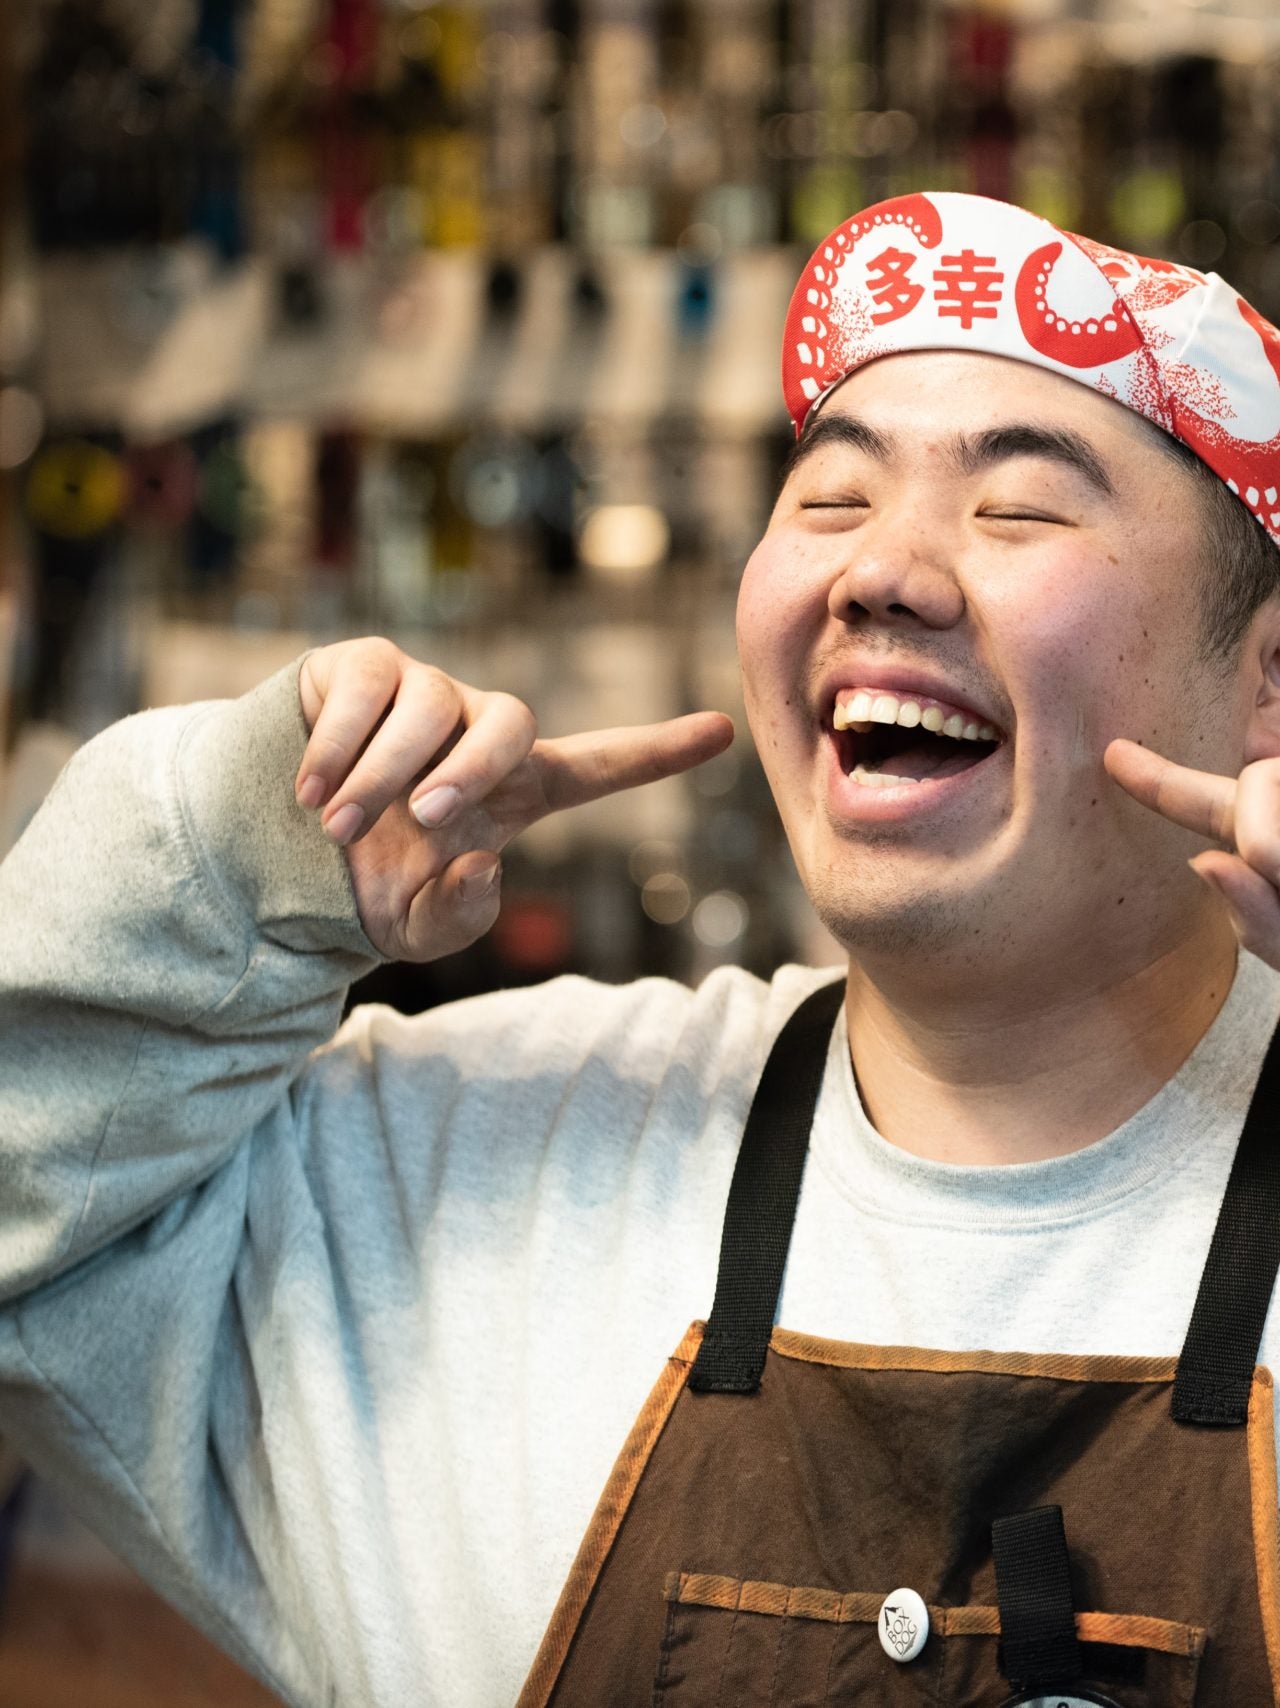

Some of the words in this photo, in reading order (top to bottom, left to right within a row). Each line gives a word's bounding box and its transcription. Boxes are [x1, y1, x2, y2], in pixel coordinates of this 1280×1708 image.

[865, 246, 1004, 330] 多幸
[887, 1608, 910, 1645] BOX
[894, 1619, 918, 1656] DOG
